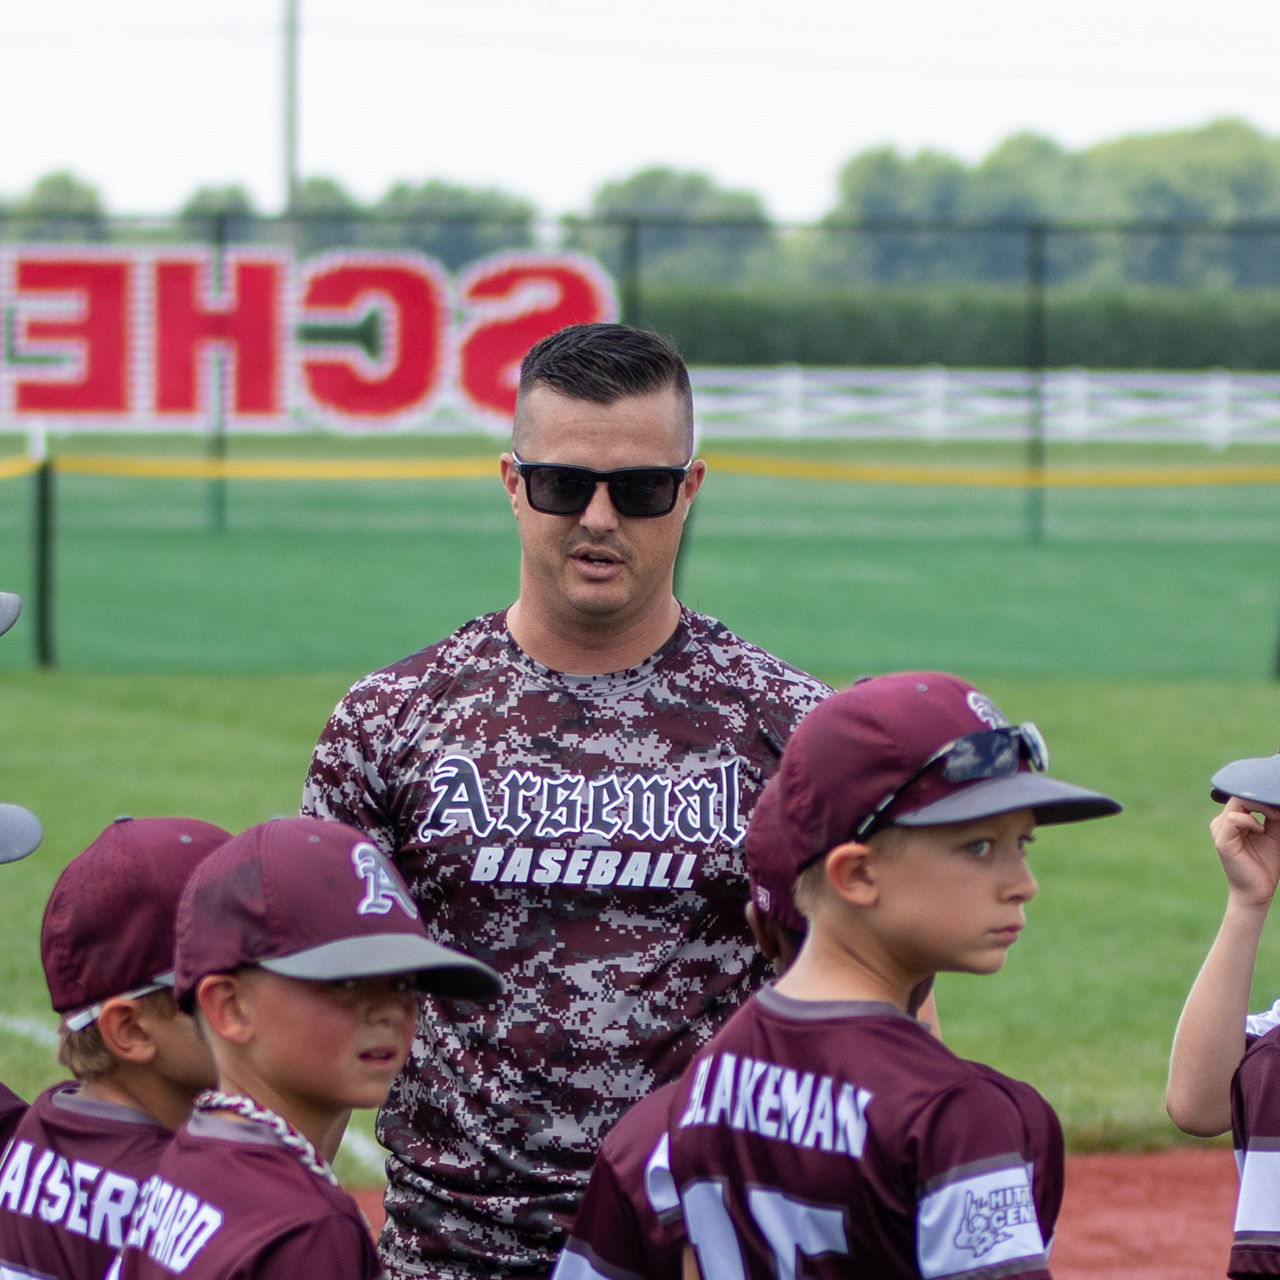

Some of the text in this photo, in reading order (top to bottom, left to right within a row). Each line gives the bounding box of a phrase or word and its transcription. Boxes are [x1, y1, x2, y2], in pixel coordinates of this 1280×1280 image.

[419, 754, 748, 845] Arsenal
[351, 842, 418, 919] A
[470, 846, 697, 889] BASEBALL
